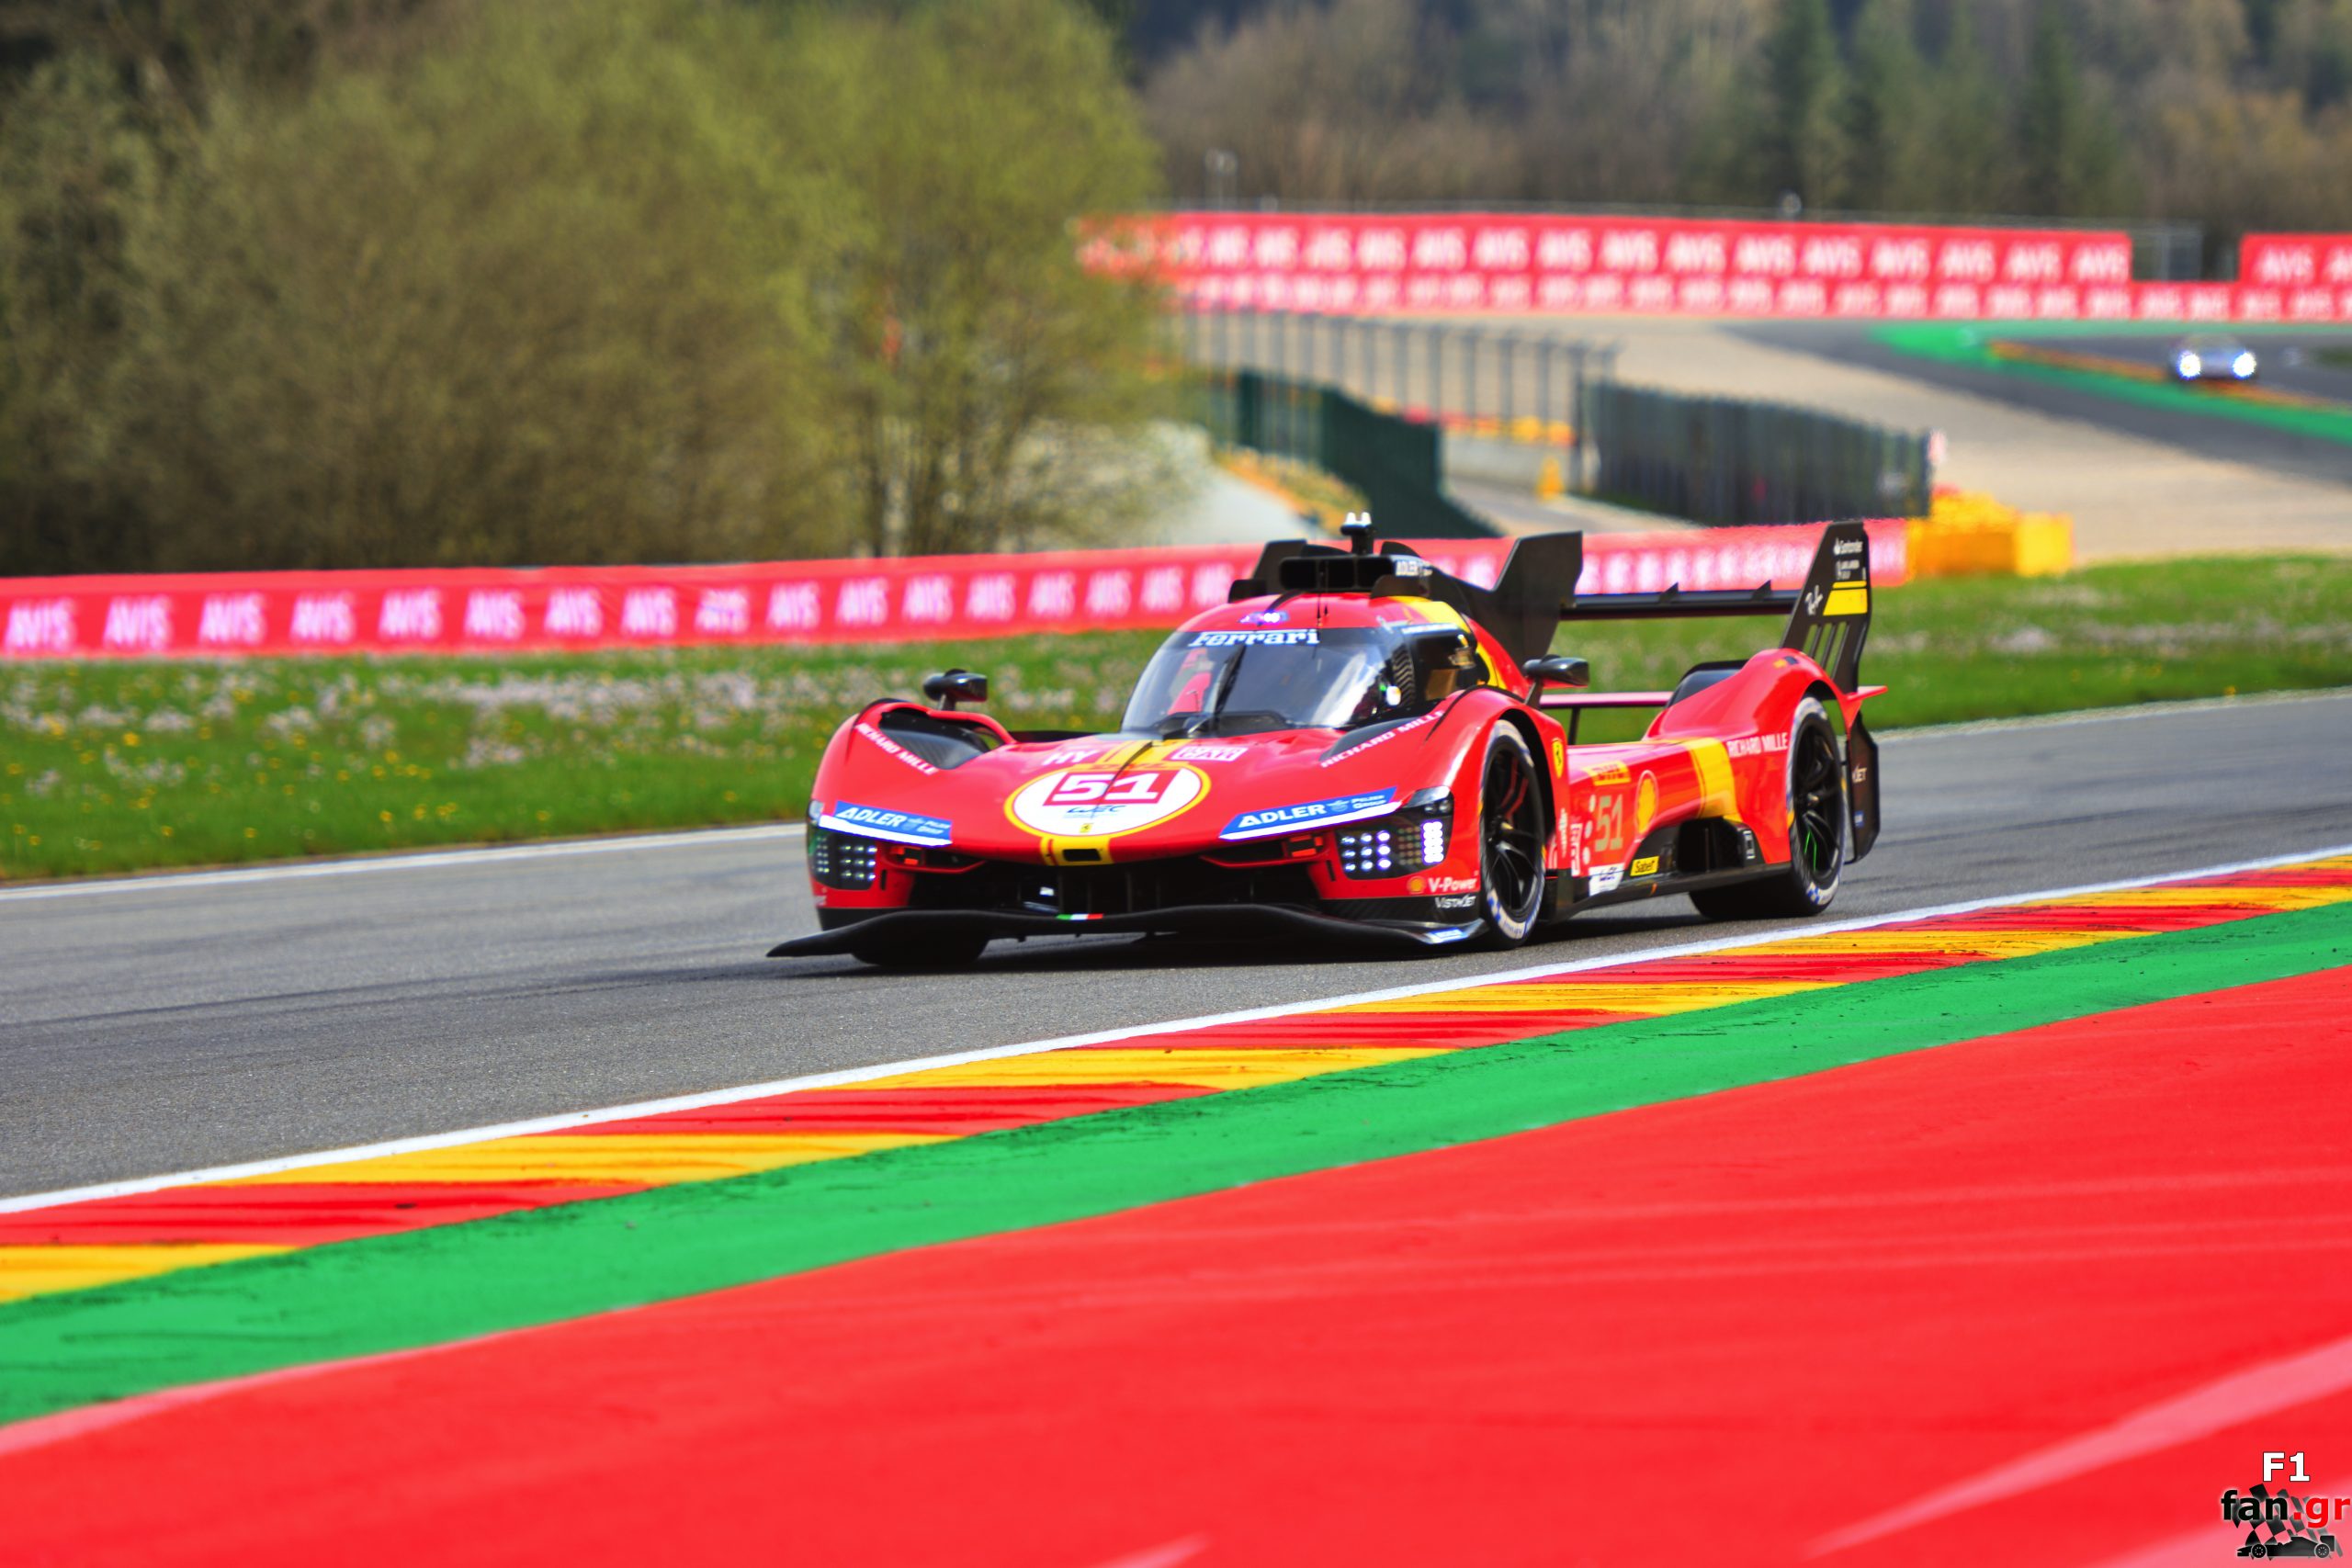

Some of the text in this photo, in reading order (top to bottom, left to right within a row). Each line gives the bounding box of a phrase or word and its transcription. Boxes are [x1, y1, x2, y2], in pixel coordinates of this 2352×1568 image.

[1188, 628, 1320, 647] Ferrari
[1320, 710, 1445, 768] RICHARD MILLE
[1726, 732, 1789, 758] RICHARD MILLE
[897, 748, 939, 775] MILLE
[1050, 773, 1160, 802] 51
[835, 807, 908, 828] ADLER
[1238, 804, 1328, 828] ADLER
[1594, 793, 1624, 852] 51
[1428, 876, 1478, 893] V-Power
